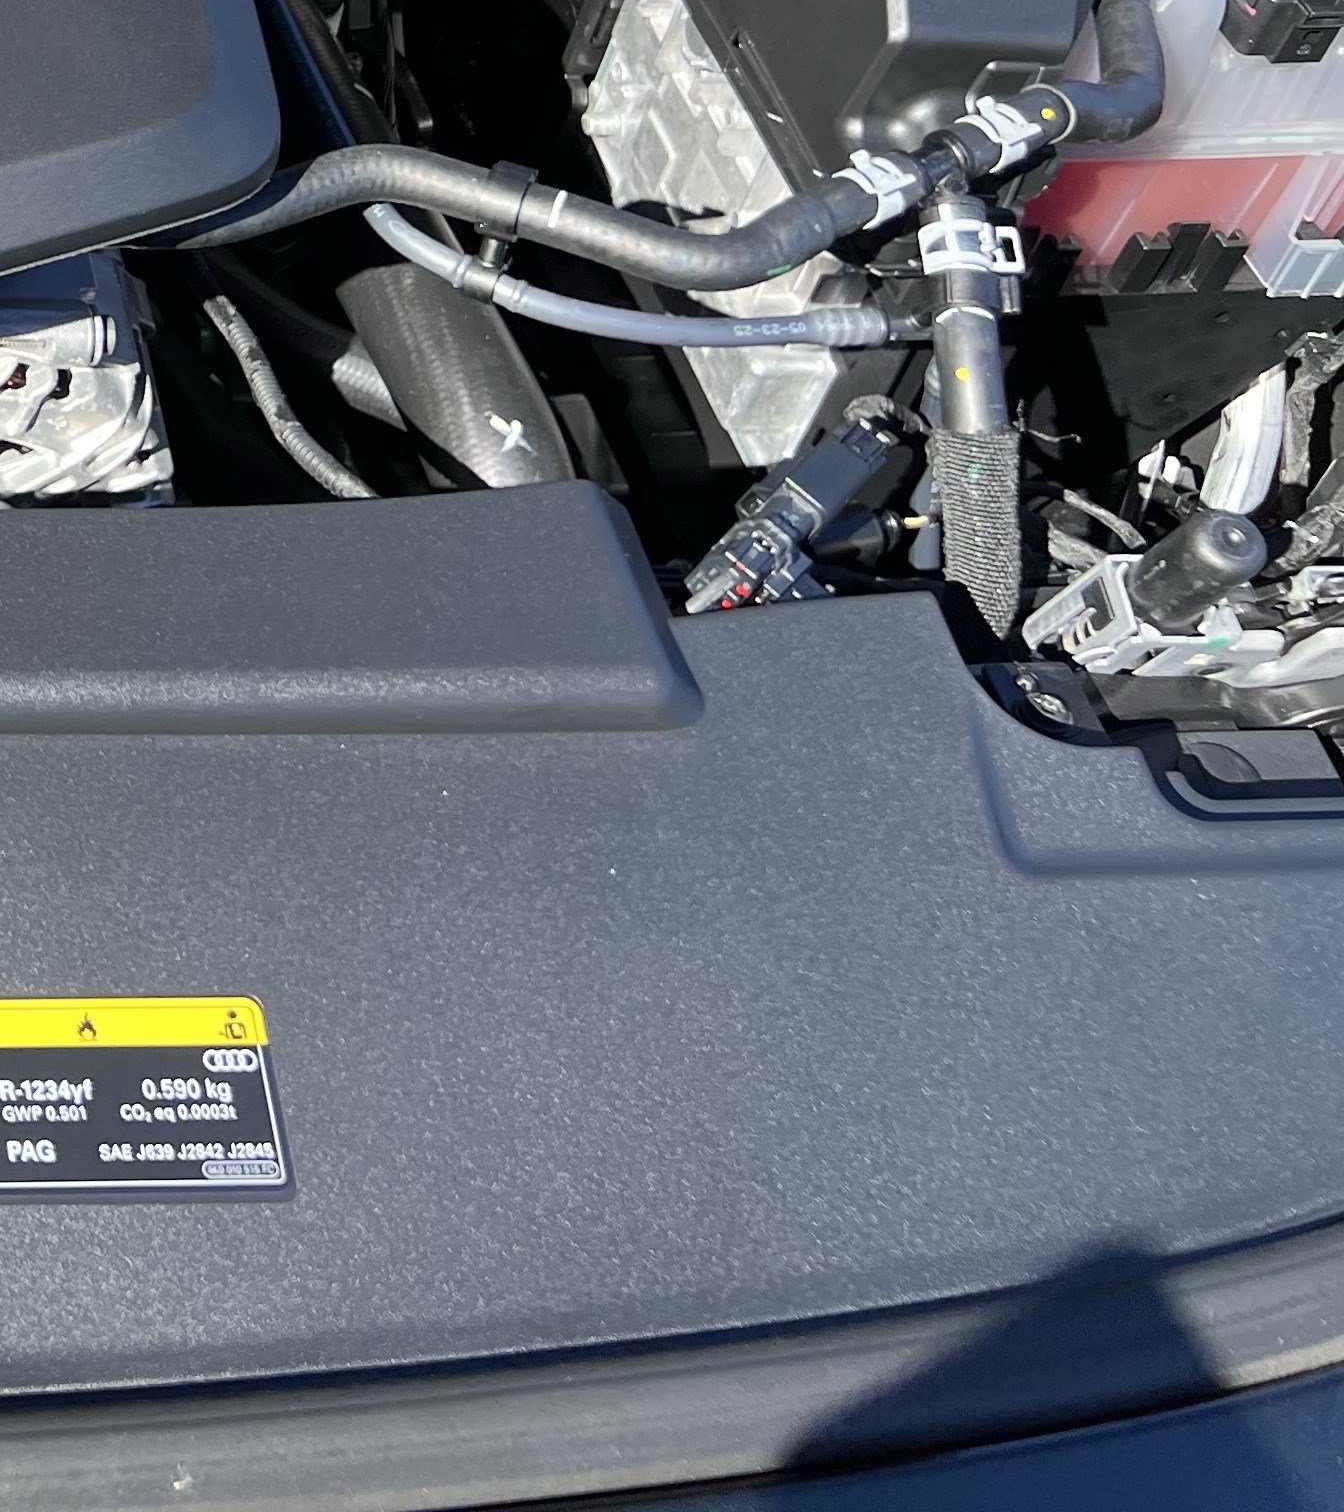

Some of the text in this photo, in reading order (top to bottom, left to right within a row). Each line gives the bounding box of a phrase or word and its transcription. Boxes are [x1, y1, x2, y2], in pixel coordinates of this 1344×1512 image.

[142, 1078, 232, 1102] 0.590 kg
[2, 1105, 87, 1122] GWP 0.501
[154, 1107, 176, 1123] eq
[178, 1103, 238, 1121] 0.0003t
[6, 1140, 57, 1163] PAG
[99, 1143, 134, 1162] SAE
[136, 1143, 174, 1161] J639
[177, 1142, 224, 1160] J2842
